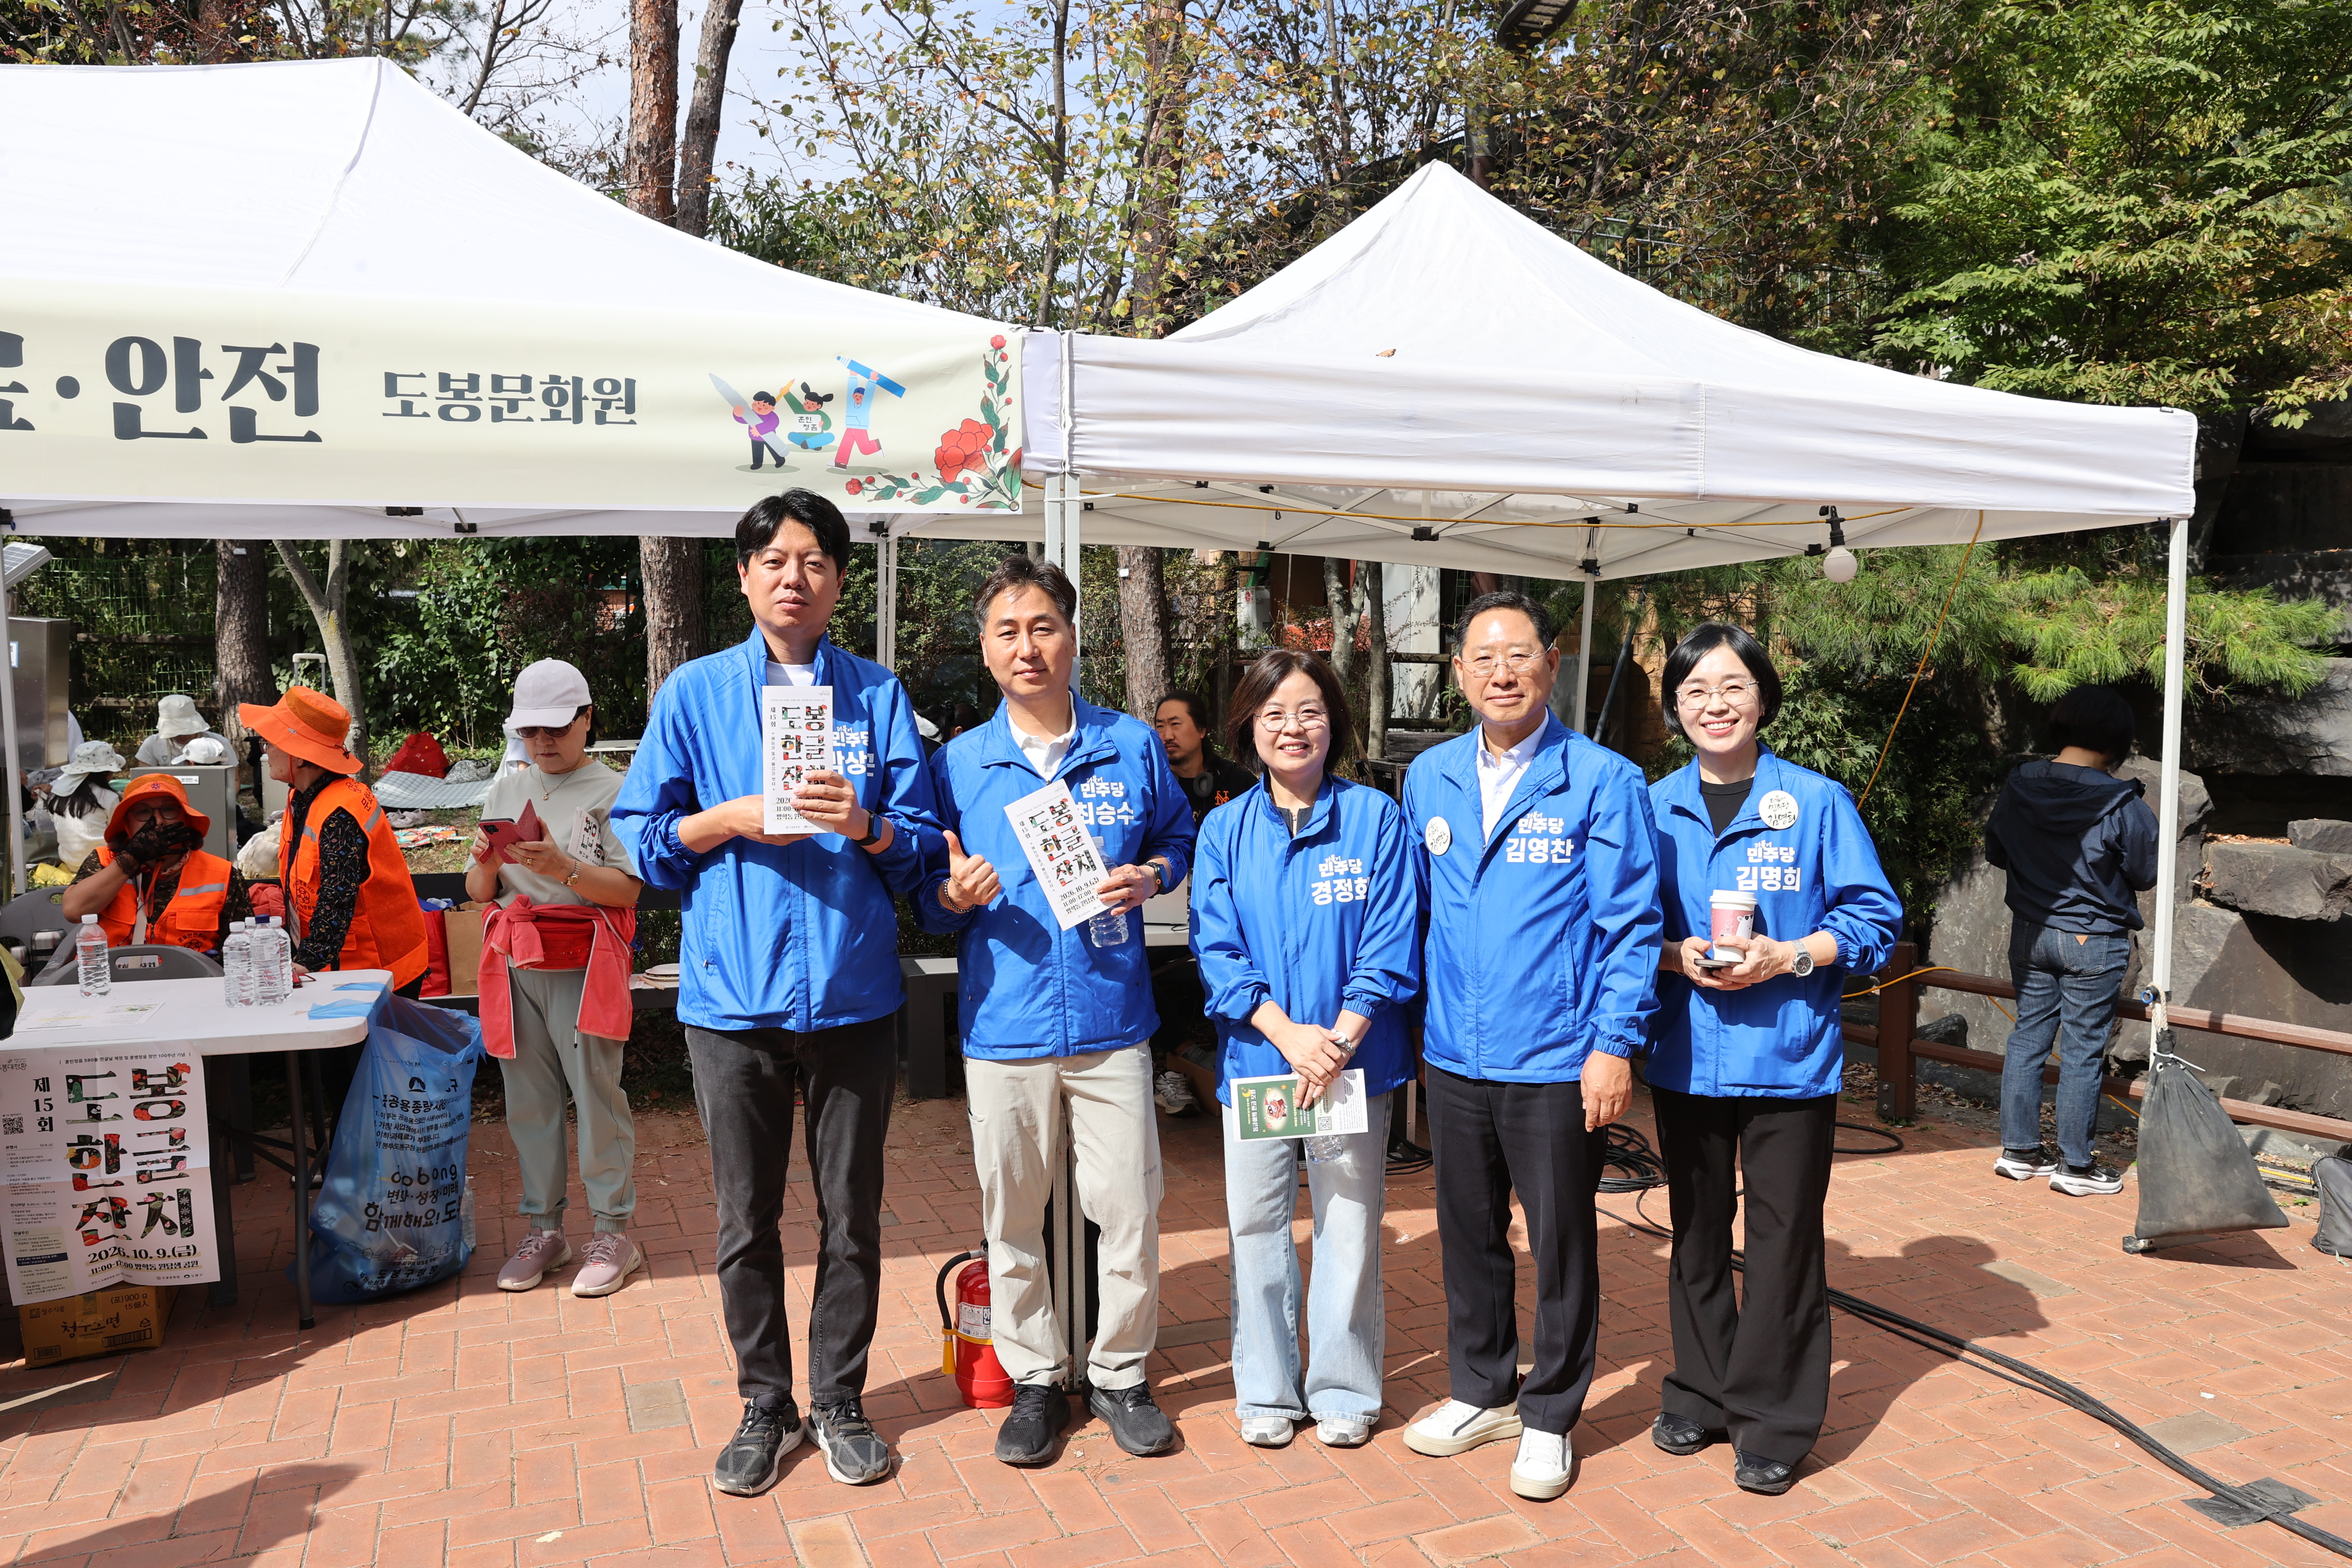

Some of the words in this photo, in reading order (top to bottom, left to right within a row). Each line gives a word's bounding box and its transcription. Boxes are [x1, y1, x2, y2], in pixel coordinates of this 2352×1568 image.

[382, 371, 637, 426] 도봉문화원
[781, 704, 827, 731] 도봉
[836, 725, 852, 733] 더불어
[781, 735, 826, 760] 한글
[1086, 775, 1103, 783] 더불어
[1080, 782, 1124, 798] 민주당
[1076, 801, 1134, 825] 최승수
[1769, 801, 1789, 812] 민주당
[1029, 798, 1073, 837] 도봉
[1518, 818, 1565, 834] 민주당
[1767, 812, 1795, 826] 김명희
[1040, 825, 1085, 862] 한글
[1505, 837, 1574, 864] 김영찬
[1754, 840, 1772, 848] 더불어
[1324, 854, 1341, 863] 더불어
[1746, 846, 1795, 863] 민주당
[1052, 849, 1096, 887] 잔치
[1319, 858, 1362, 877] 민주당
[1736, 867, 1801, 891] 김명희
[1063, 890, 1091, 907] 11:00-17:00
[1066, 903, 1081, 914] 방학동
[1080, 896, 1095, 906] 원당샘
[66, 1062, 191, 1124] 도봉
[1251, 1101, 1257, 1111] 한글
[394, 1123, 421, 1134] 사업장에서
[392, 1133, 415, 1142] 과태료가
[65, 1127, 191, 1191] 한글
[391, 1164, 457, 1187] dobong
[72, 1188, 195, 1246] 잔치
[91, 1259, 134, 1274] 11:00-17:00
[158, 1262, 181, 1270] 원당샘
[110, 1293, 139, 1305] (포)900
[124, 1301, 149, 1311] 15個入
